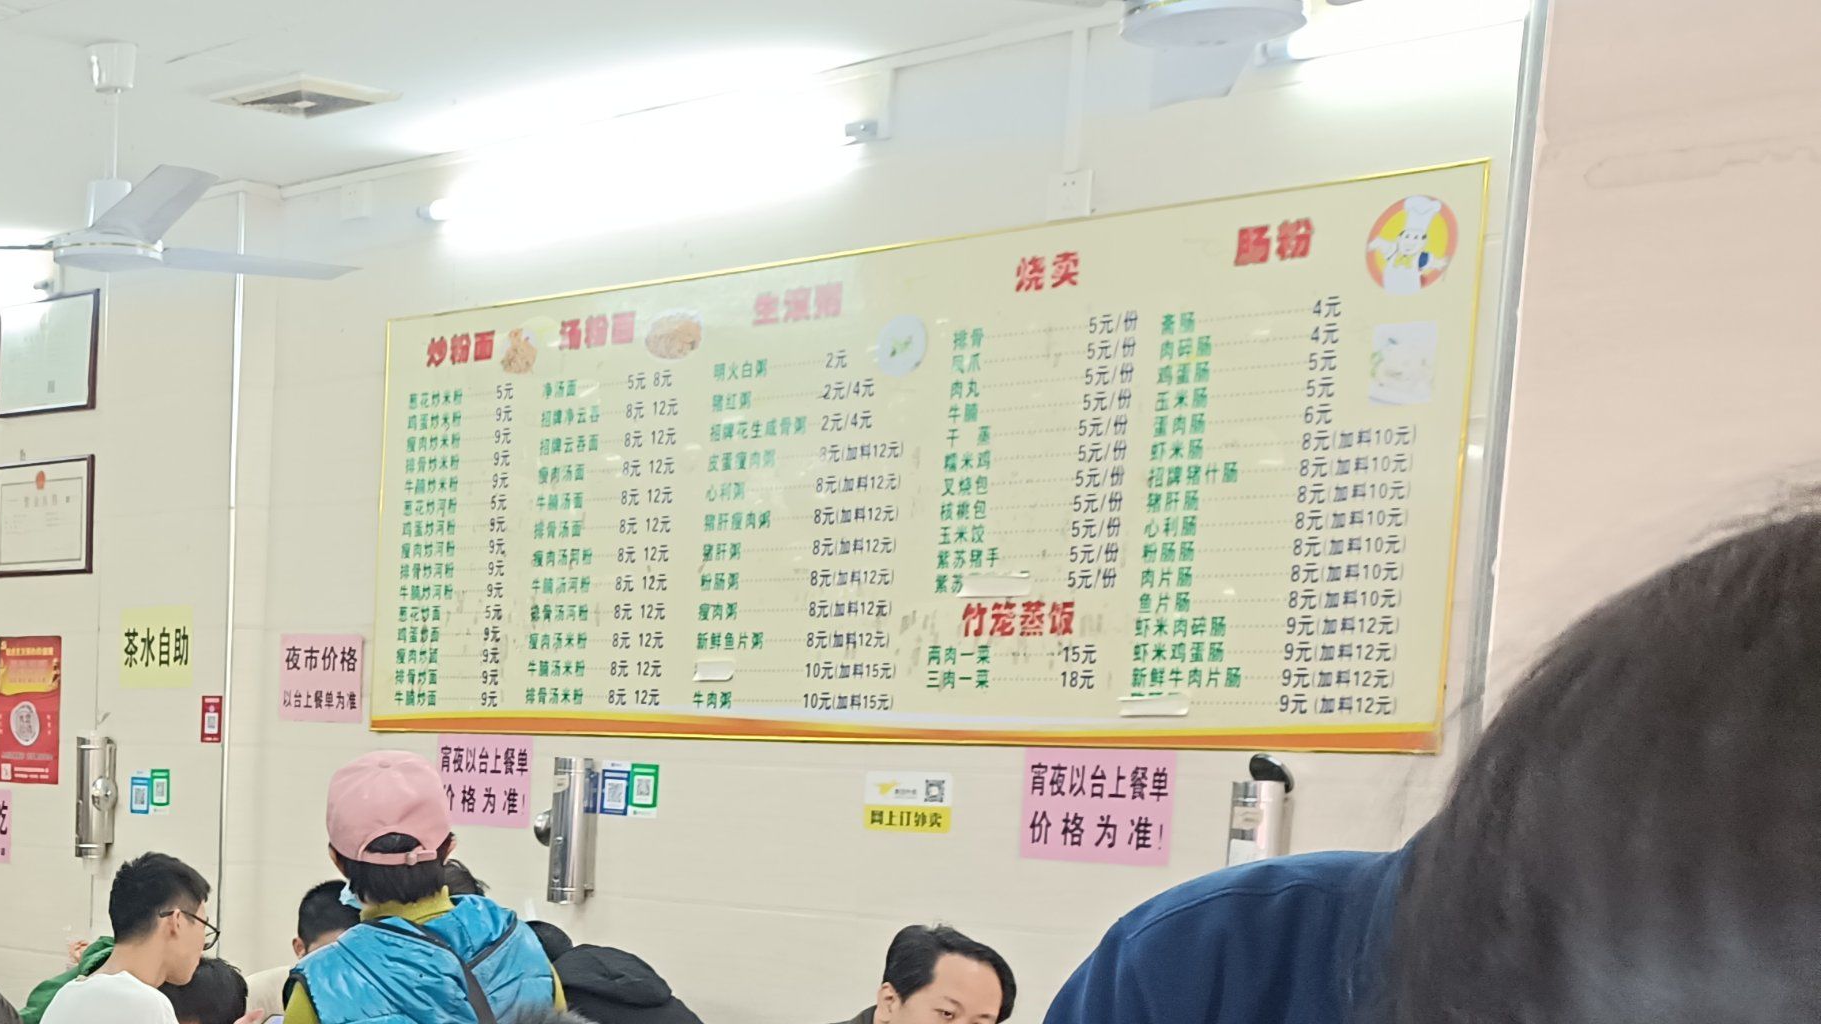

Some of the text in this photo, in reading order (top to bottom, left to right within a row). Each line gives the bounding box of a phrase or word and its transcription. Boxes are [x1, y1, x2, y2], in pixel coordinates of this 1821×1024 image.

[1233, 218, 1314, 267] 肠粉
[1015, 252, 1080, 293] 烧卖
[1313, 296, 1342, 317] 4元
[1089, 310, 1138, 334] 5元/份
[1311, 323, 1339, 345] 4元
[1087, 336, 1136, 360] 5元/份
[825, 349, 848, 369] 2元
[1309, 350, 1338, 371] 5元
[627, 370, 673, 390] 5元 8元
[1085, 362, 1134, 386] 5元/份
[496, 383, 514, 400] 5元
[822, 379, 875, 400] 2元/4元
[1306, 376, 1335, 398] 5元
[626, 398, 678, 419] 8元 12元
[1083, 388, 1132, 411] 5元/份
[495, 405, 512, 422] 9元
[821, 410, 873, 431] 2元/4元
[1304, 403, 1333, 424] 6元
[1079, 414, 1128, 437] 5元/份
[494, 428, 511, 445] 9元
[624, 428, 677, 448] 8元 12元
[493, 450, 510, 467] 9元
[1078, 440, 1127, 463] 5元/份
[623, 457, 675, 477] 8元 12元
[1076, 466, 1124, 488] 5元/份
[492, 472, 509, 489] 9元
[491, 495, 507, 511] 5元
[621, 486, 673, 506] 8元 12元
[1073, 491, 1123, 513] 5元/份
[489, 516, 506, 532] 9元
[619, 517, 638, 535] 8元
[646, 516, 671, 533] 12元
[1072, 517, 1121, 538] 5元/份
[488, 538, 506, 554] 9元
[618, 546, 636, 563] 8元
[645, 544, 669, 562] 12元
[1070, 543, 1118, 564] 5元/份
[488, 560, 505, 577] 9元
[1067, 568, 1117, 589] 5元/份
[487, 582, 503, 598] 9元
[615, 574, 667, 592] 8元 12元
[485, 604, 502, 620] 5元
[614, 603, 632, 620] 8元
[641, 603, 666, 620] 12元
[962, 600, 1075, 637] 竹笼蒸饭
[484, 626, 501, 642] 9元
[612, 632, 631, 649] 8元
[639, 631, 664, 649] 12元
[124, 626, 189, 668] 茶水自助
[483, 648, 499, 663] 9元
[1063, 645, 1097, 665] 15元
[285, 645, 358, 672] 夜市价格
[610, 660, 629, 677] 8元
[637, 660, 662, 677] 12元
[482, 669, 498, 686] 9元
[1061, 670, 1095, 690] 18元
[283, 690, 357, 710] 以台上餐单为准
[481, 691, 498, 707] 9元
[608, 688, 627, 705] 8元
[635, 688, 660, 706] 12元
[693, 691, 732, 709] 牛肉粥
[441, 745, 528, 775] 宵夜以台上餐单
[1031, 761, 1169, 801] 宵夜以台上餐单
